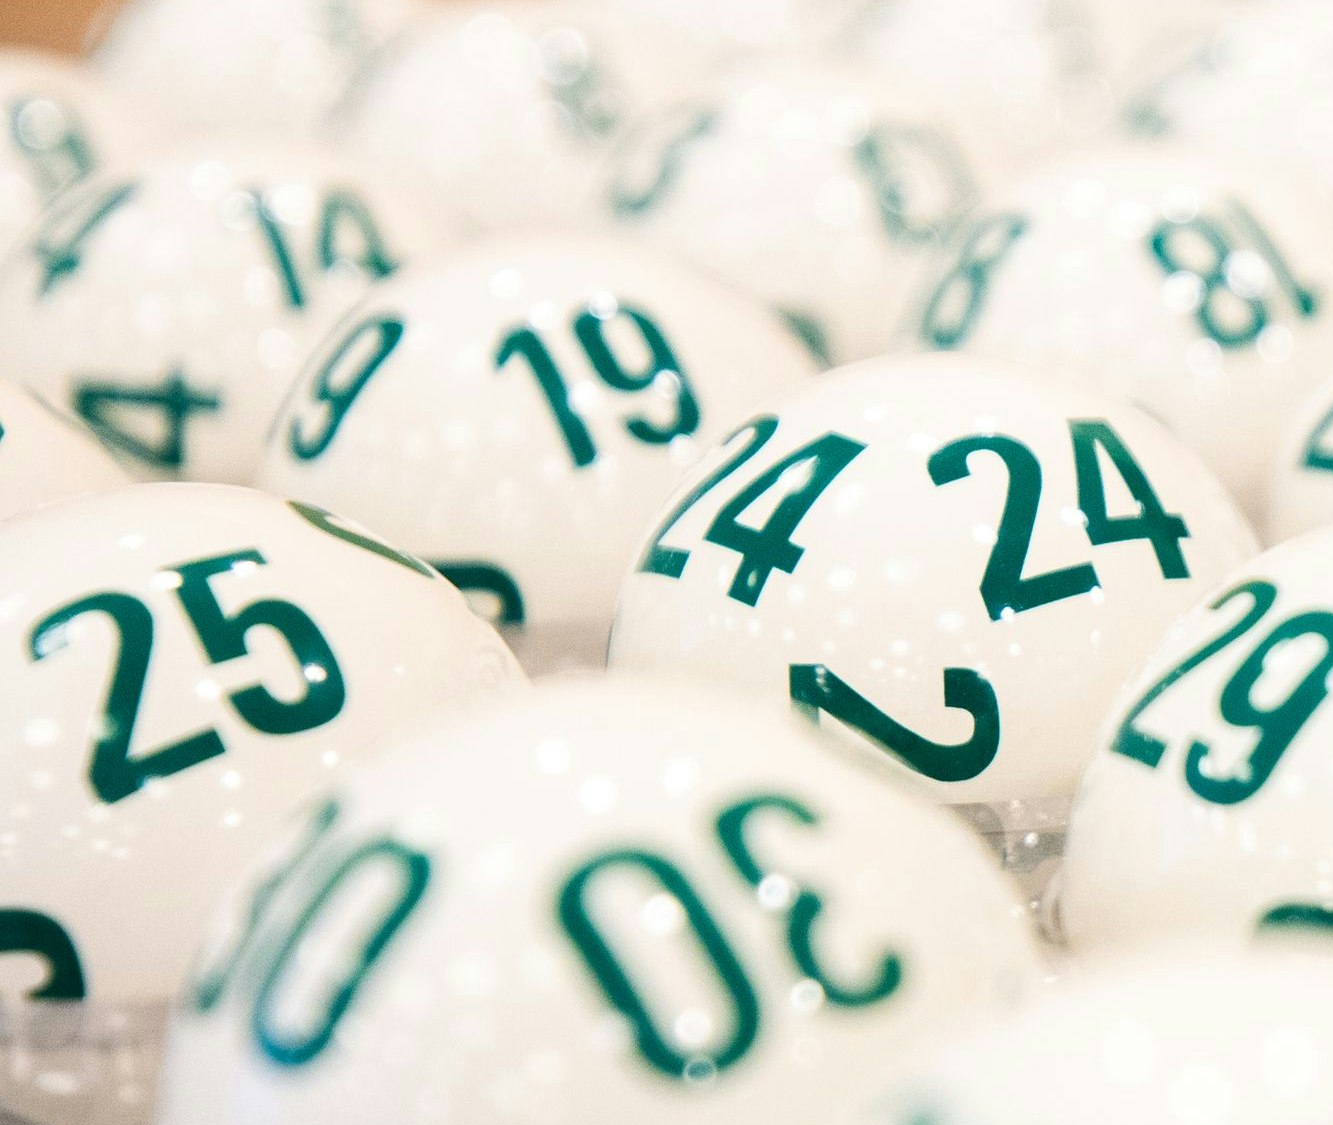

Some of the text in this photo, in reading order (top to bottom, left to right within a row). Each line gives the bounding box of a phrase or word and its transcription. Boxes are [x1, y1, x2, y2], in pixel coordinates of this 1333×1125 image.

[490, 300, 705, 472] 19
[632, 410, 870, 610] 24
[922, 415, 1195, 625] 24
[25, 545, 350, 806] 25
